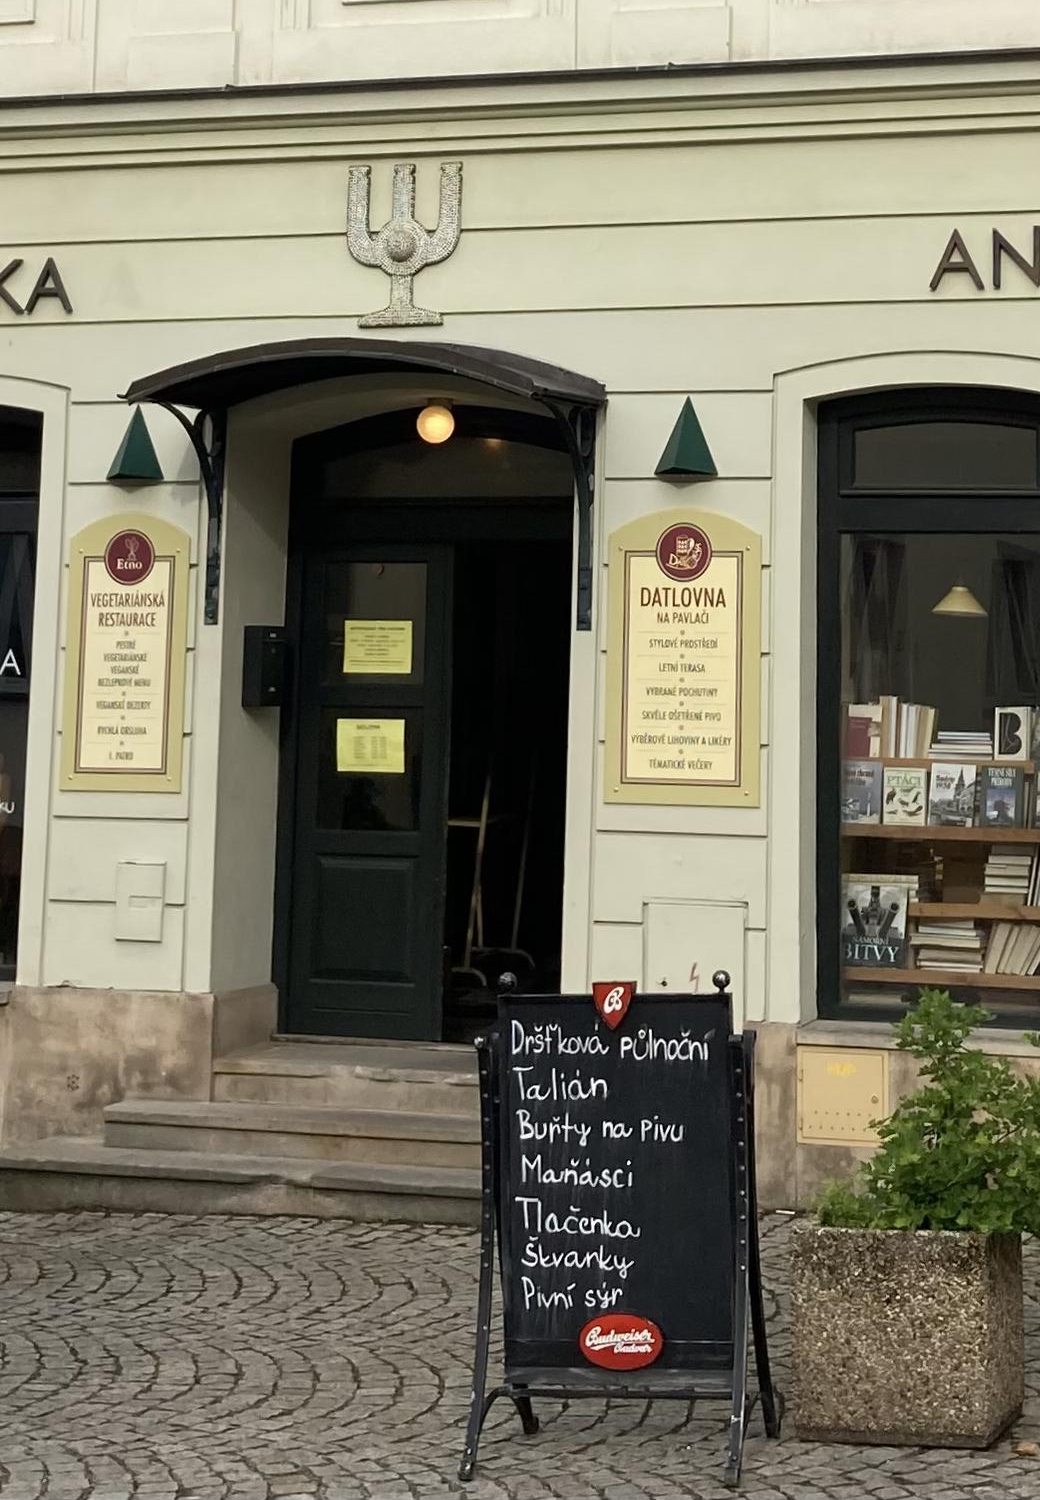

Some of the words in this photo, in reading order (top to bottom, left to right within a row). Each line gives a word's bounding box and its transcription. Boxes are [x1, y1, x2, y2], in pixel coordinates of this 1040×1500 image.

[117, 558, 143, 570] Etno
[91, 589, 165, 608] VEGETARIÁNSKÁ
[640, 587, 727, 609] DATLOVNA
[98, 612, 157, 628] RESTAURACE
[656, 612, 670, 624] NA
[672, 610, 709, 625] PAVLAČI
[649, 637, 678, 649] STYLOVÉ
[679, 637, 718, 649] PROSTŘEDÍ
[658, 662, 678, 673] LETNÍ
[680, 663, 706, 673] TERASA
[646, 685, 677, 697] VYBRANÉ
[679, 687, 718, 697] POCHUTINY
[704, 712, 721, 721] PIVO
[631, 733, 666, 745] VÝBĚROVÉ
[667, 735, 700, 745] LIHOVINY
[701, 736, 707, 745] A
[708, 734, 731, 746] LIKÉRY
[649, 757, 686, 770] TÉMATICKÉ
[687, 758, 713, 770] VEČERY
[512, 1065, 608, 1101] Talián
[516, 1109, 591, 1147] Buřty
[602, 1120, 633, 1138] na
[521, 1154, 633, 1188] Maňásci
[515, 1196, 641, 1238] Tlačenka
[521, 1235, 635, 1279] Škvarky
[521, 1276, 576, 1310] Pivní
[584, 1282, 623, 1308] sýr
[585, 1326, 655, 1350] Budweiser
[613, 1343, 653, 1354] Budvar
